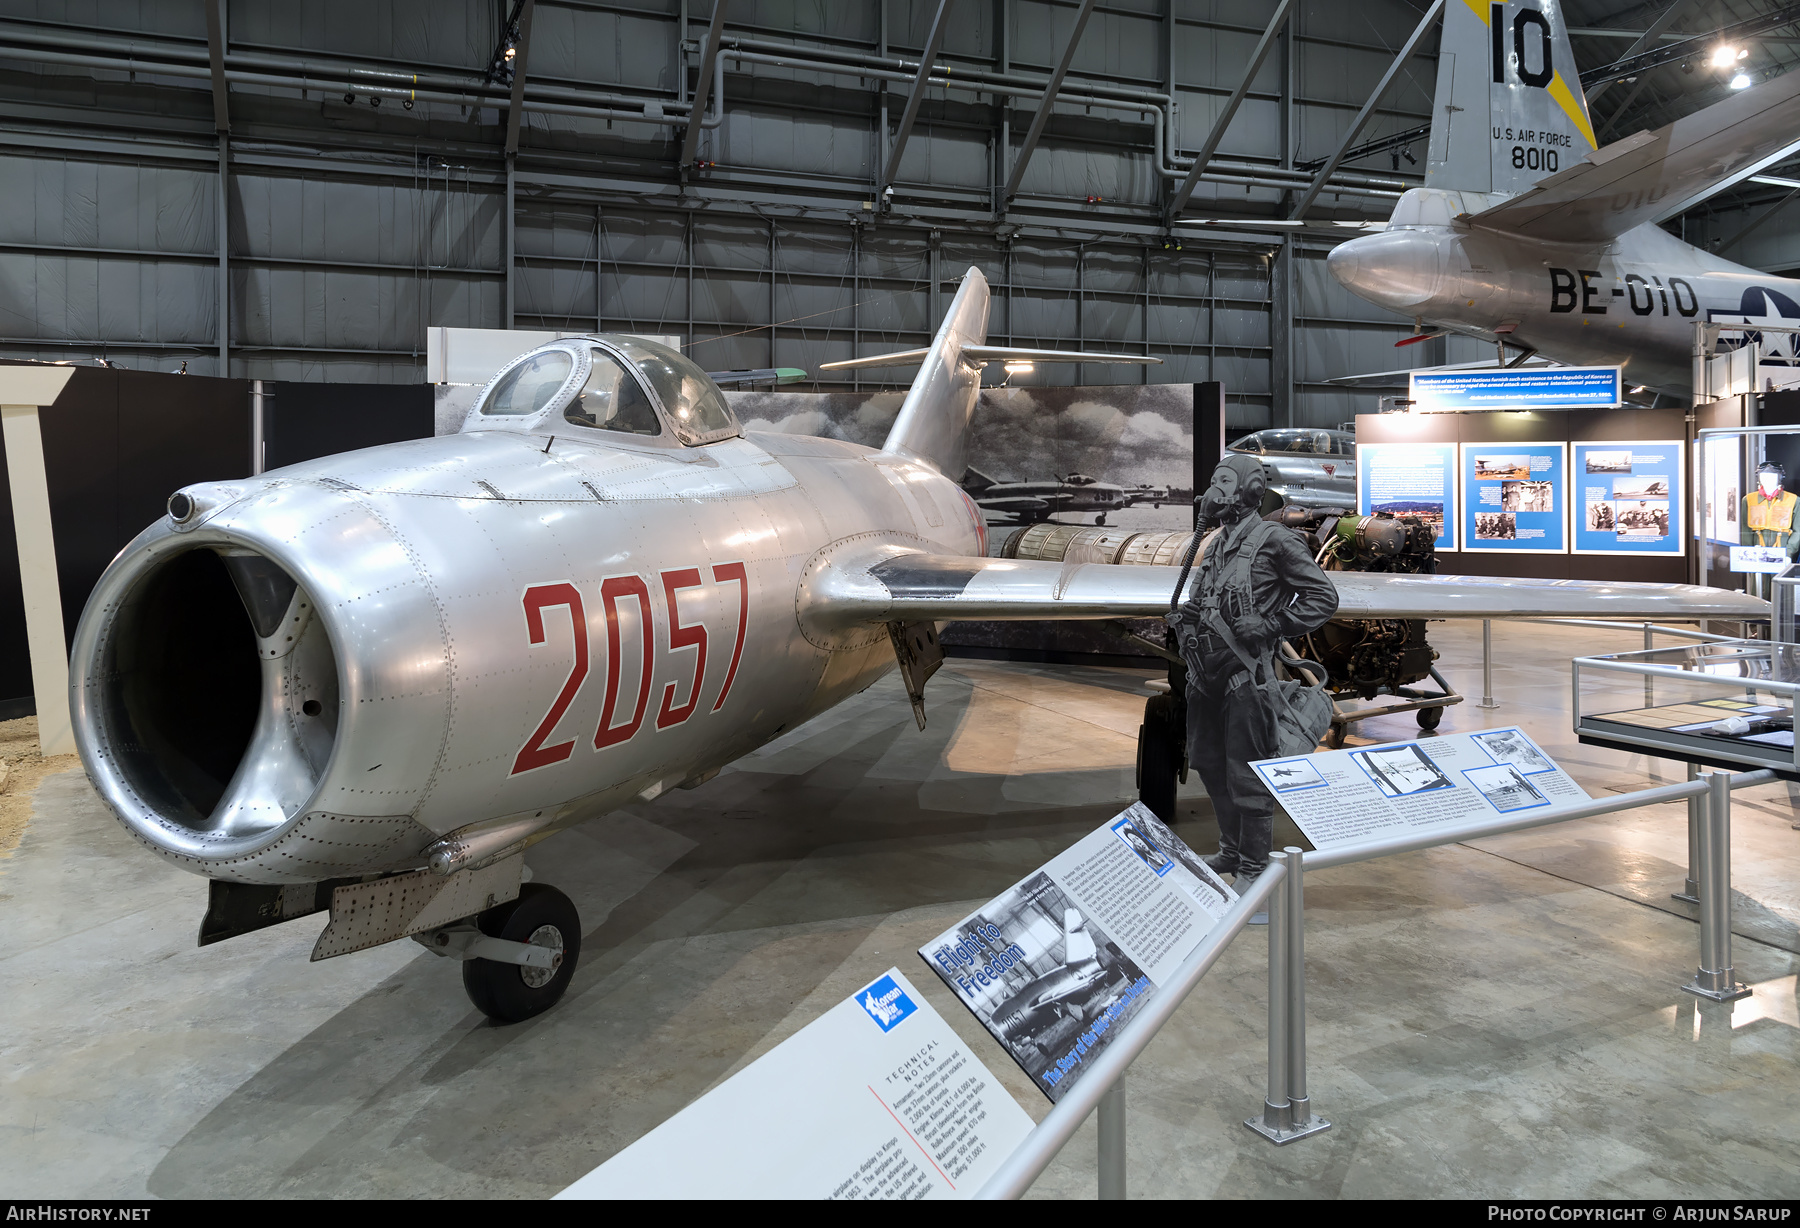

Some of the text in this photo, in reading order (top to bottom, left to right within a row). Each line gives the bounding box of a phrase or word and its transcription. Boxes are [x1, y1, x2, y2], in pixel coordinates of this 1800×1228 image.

[1492, 3, 1553, 88] 10
[1493, 127, 1571, 147] U.S. AIR FORCE
[1512, 146, 1558, 172] 8010
[1549, 268, 1699, 317] BE-010
[507, 559, 749, 779] 2057
[930, 917, 1004, 979] Flight to
[954, 936, 1028, 1000] Freedom
[1124, 972, 1151, 1001] Display
[874, 987, 902, 1009] Korean
[881, 1003, 898, 1018] War
[1120, 994, 1133, 1007] on
[1002, 1009, 1028, 1032] 2057
[1080, 1027, 1098, 1047] the
[885, 1038, 939, 1084] TECHNICAL
[1054, 1046, 1082, 1076] Story
[1071, 1037, 1089, 1056] of
[891, 1049, 959, 1109] Armament: Two 23mm cannons and
[903, 1054, 935, 1082] NOTES
[1042, 1064, 1064, 1088] The
[902, 1105, 912, 1116] one
[910, 1092, 926, 1108] 37mm
[939, 1072, 950, 1083] plus
[946, 1060, 963, 1075] rockets
[908, 1086, 949, 1124] 2,000 lbs of bombs
[913, 1117, 932, 1136] Engine:
[928, 1104, 945, 1121] Klimov
[952, 1090, 959, 1099] of
[956, 1080, 971, 1095] 6,000
[968, 1075, 977, 1084] lbs
[923, 1080, 986, 1141] thrust (developed from the British
[929, 1124, 956, 1150] Rolls-Royce
[935, 1109, 987, 1161] Maximum speed: 670 mph
[942, 1133, 978, 1171] Range: 500 miles
[831, 1134, 899, 1198] airplane on display to Kimpo
[862, 1172, 875, 1186] The
[872, 1155, 894, 1177] airplane
[891, 1146, 904, 1159] pro-
[867, 1185, 879, 1197] was
[876, 1176, 887, 1188] the
[884, 1156, 909, 1180] advanced
[915, 1170, 927, 1183] and
[949, 1141, 986, 1181] Ceiling: 51,000 ft
[883, 1163, 918, 1198] the US offered
